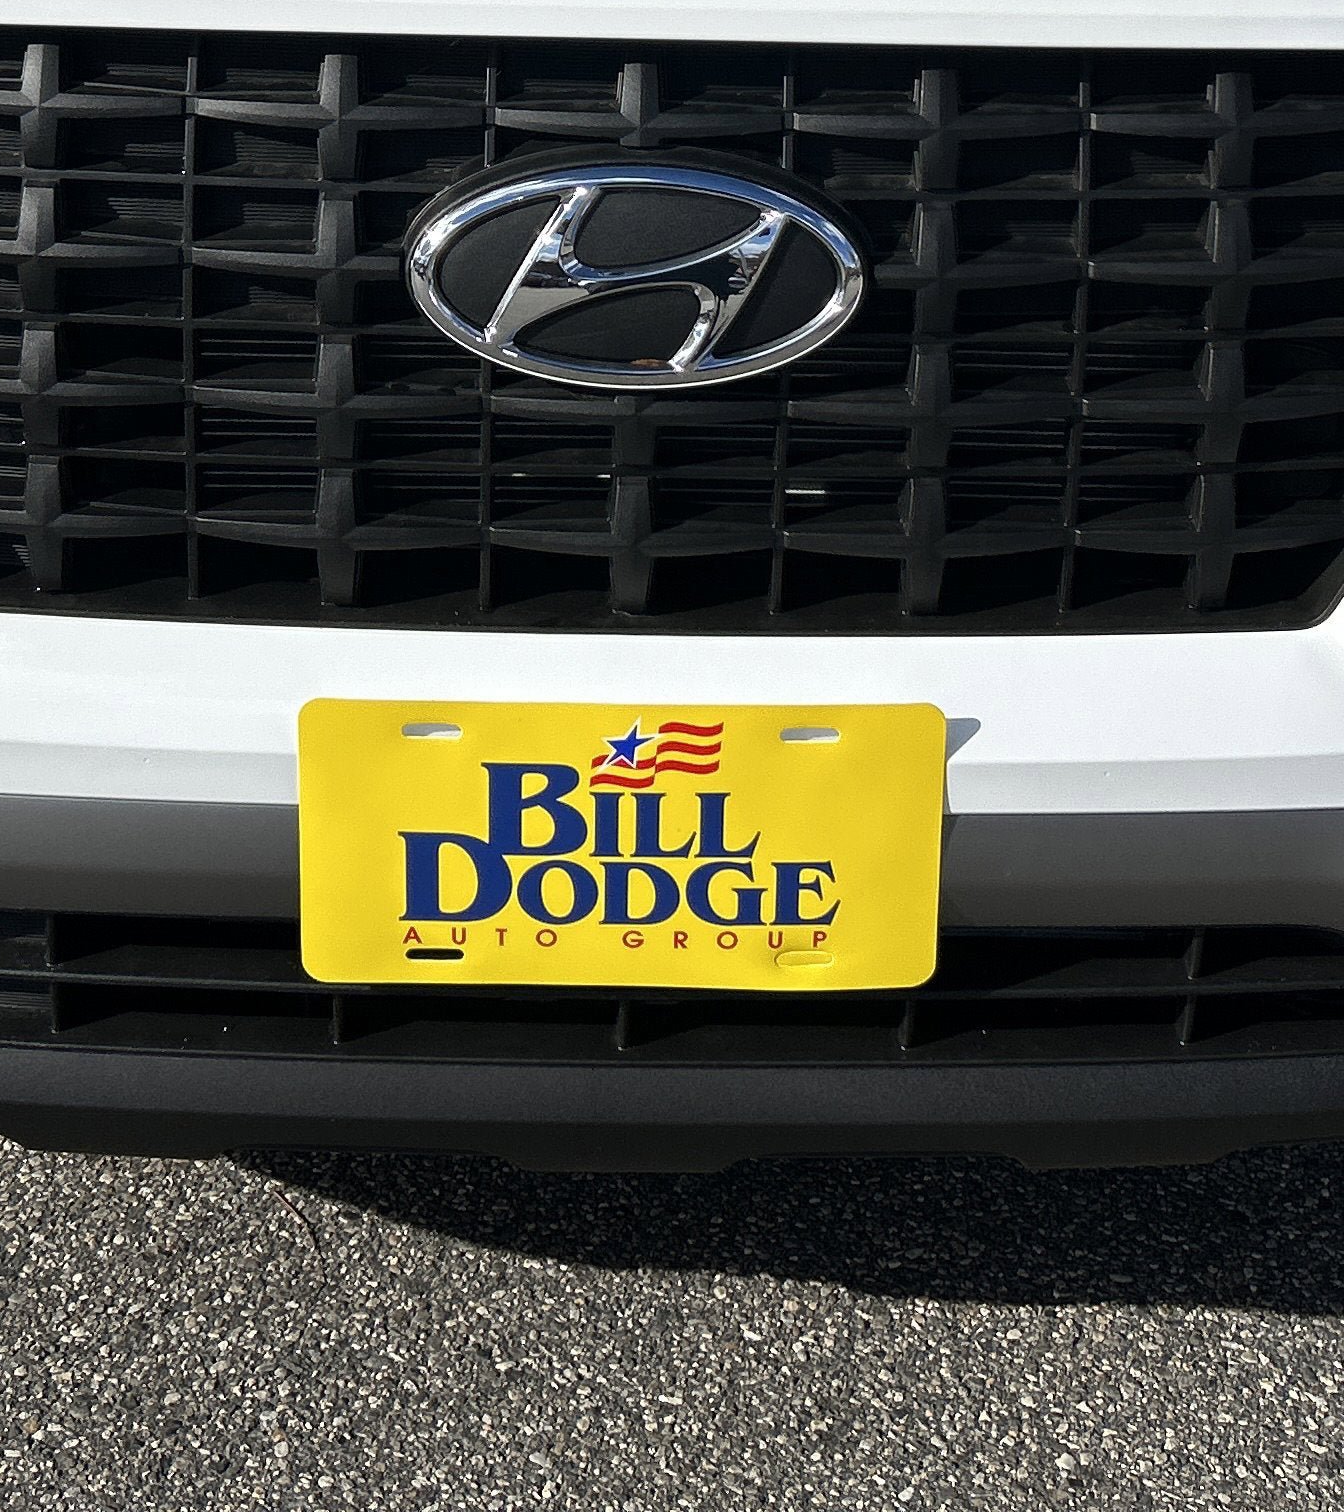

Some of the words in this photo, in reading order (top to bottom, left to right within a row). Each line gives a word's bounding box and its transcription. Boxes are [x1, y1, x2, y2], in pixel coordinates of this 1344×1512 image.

[480, 761, 761, 859] BILL
[397, 830, 842, 926] DODGE
[401, 925, 560, 949] AUTO
[621, 929, 828, 950] GROUP
